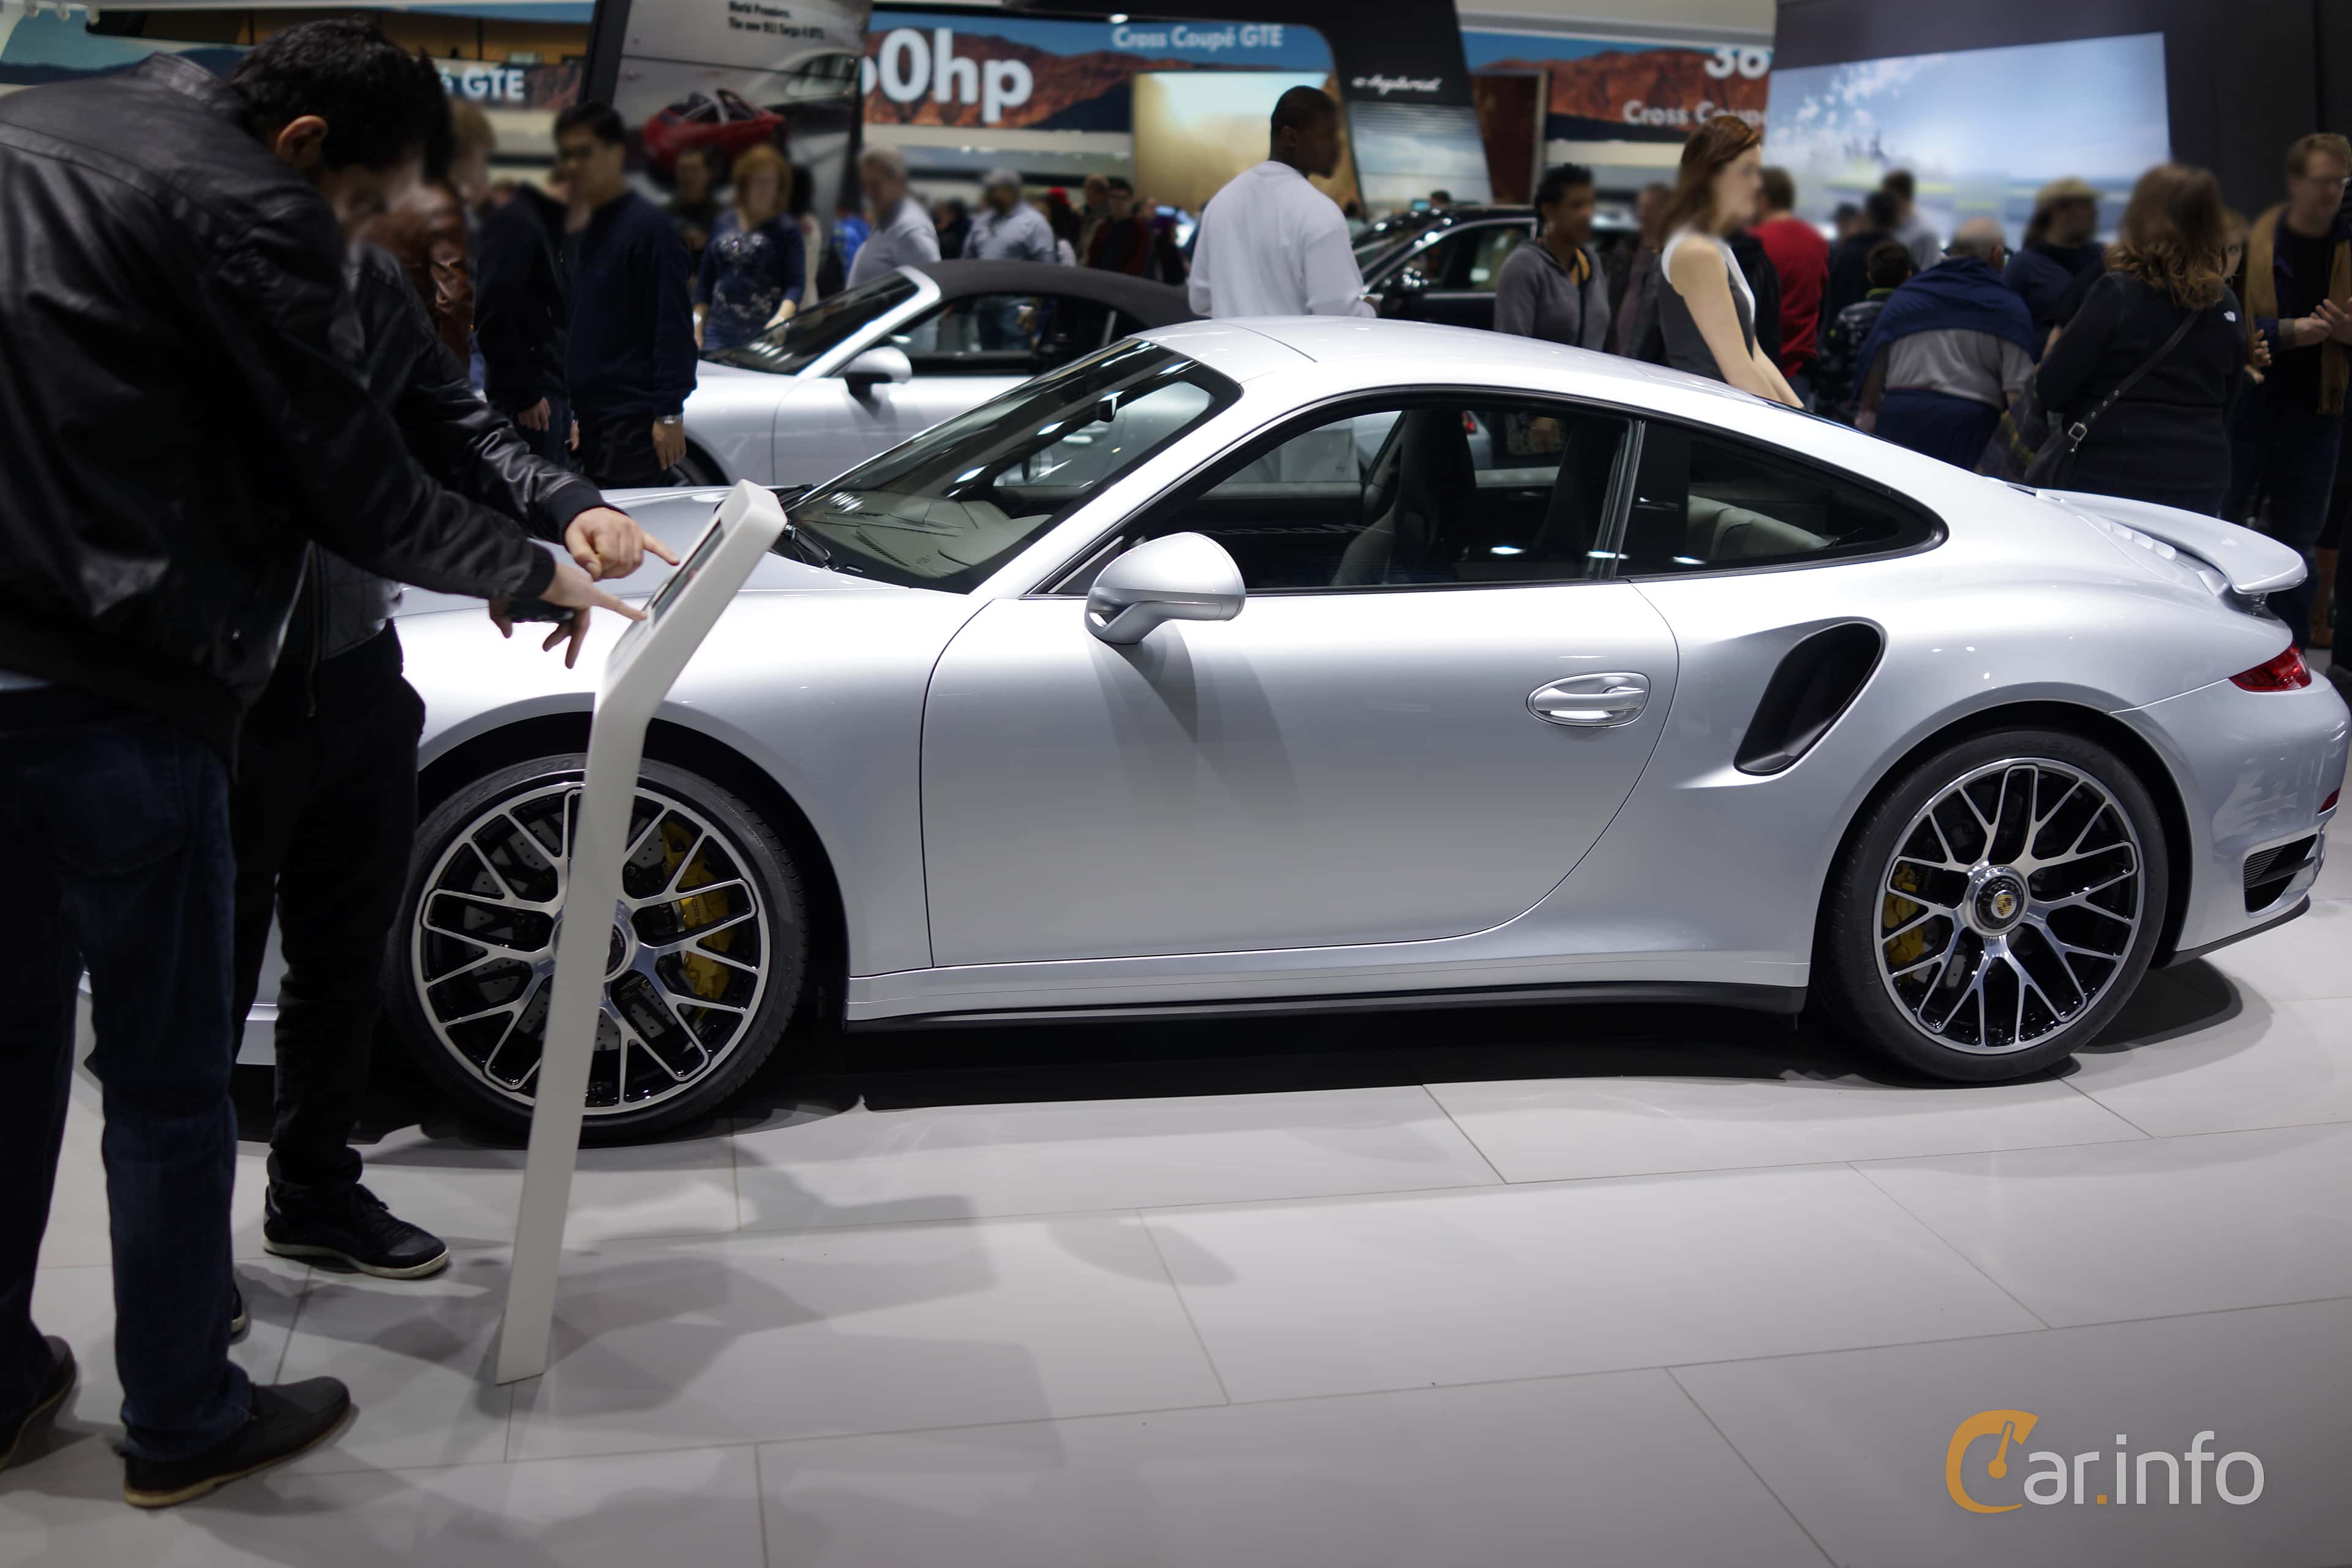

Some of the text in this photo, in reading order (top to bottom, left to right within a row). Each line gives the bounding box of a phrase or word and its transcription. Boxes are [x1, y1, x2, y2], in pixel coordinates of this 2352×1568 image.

[1111, 24, 1284, 53] Cross Coupé GTE
[462, 67, 526, 102] GTE
[1623, 100, 1689, 126] Cross
